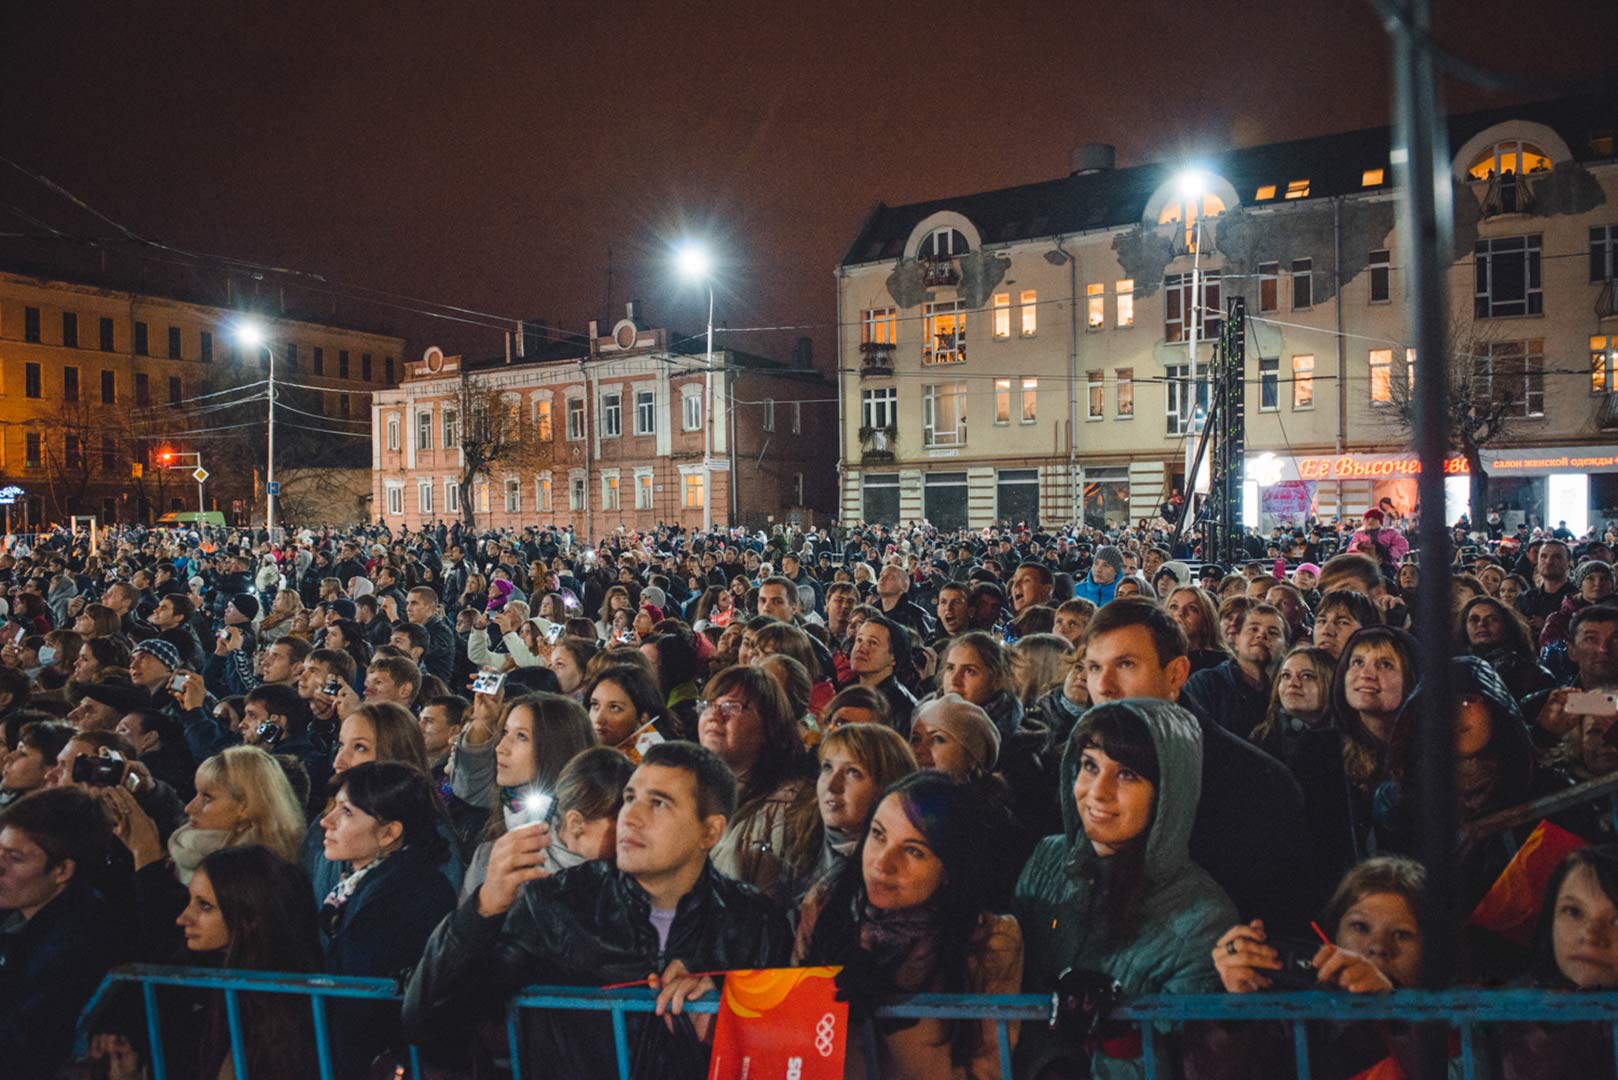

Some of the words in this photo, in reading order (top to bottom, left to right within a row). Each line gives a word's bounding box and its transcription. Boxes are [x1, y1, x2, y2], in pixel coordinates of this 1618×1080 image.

[1300, 458, 1329, 477] Её
[1493, 460, 1521, 469] салон
[1524, 457, 1568, 468] женской
[1571, 457, 1613, 467] одежды
